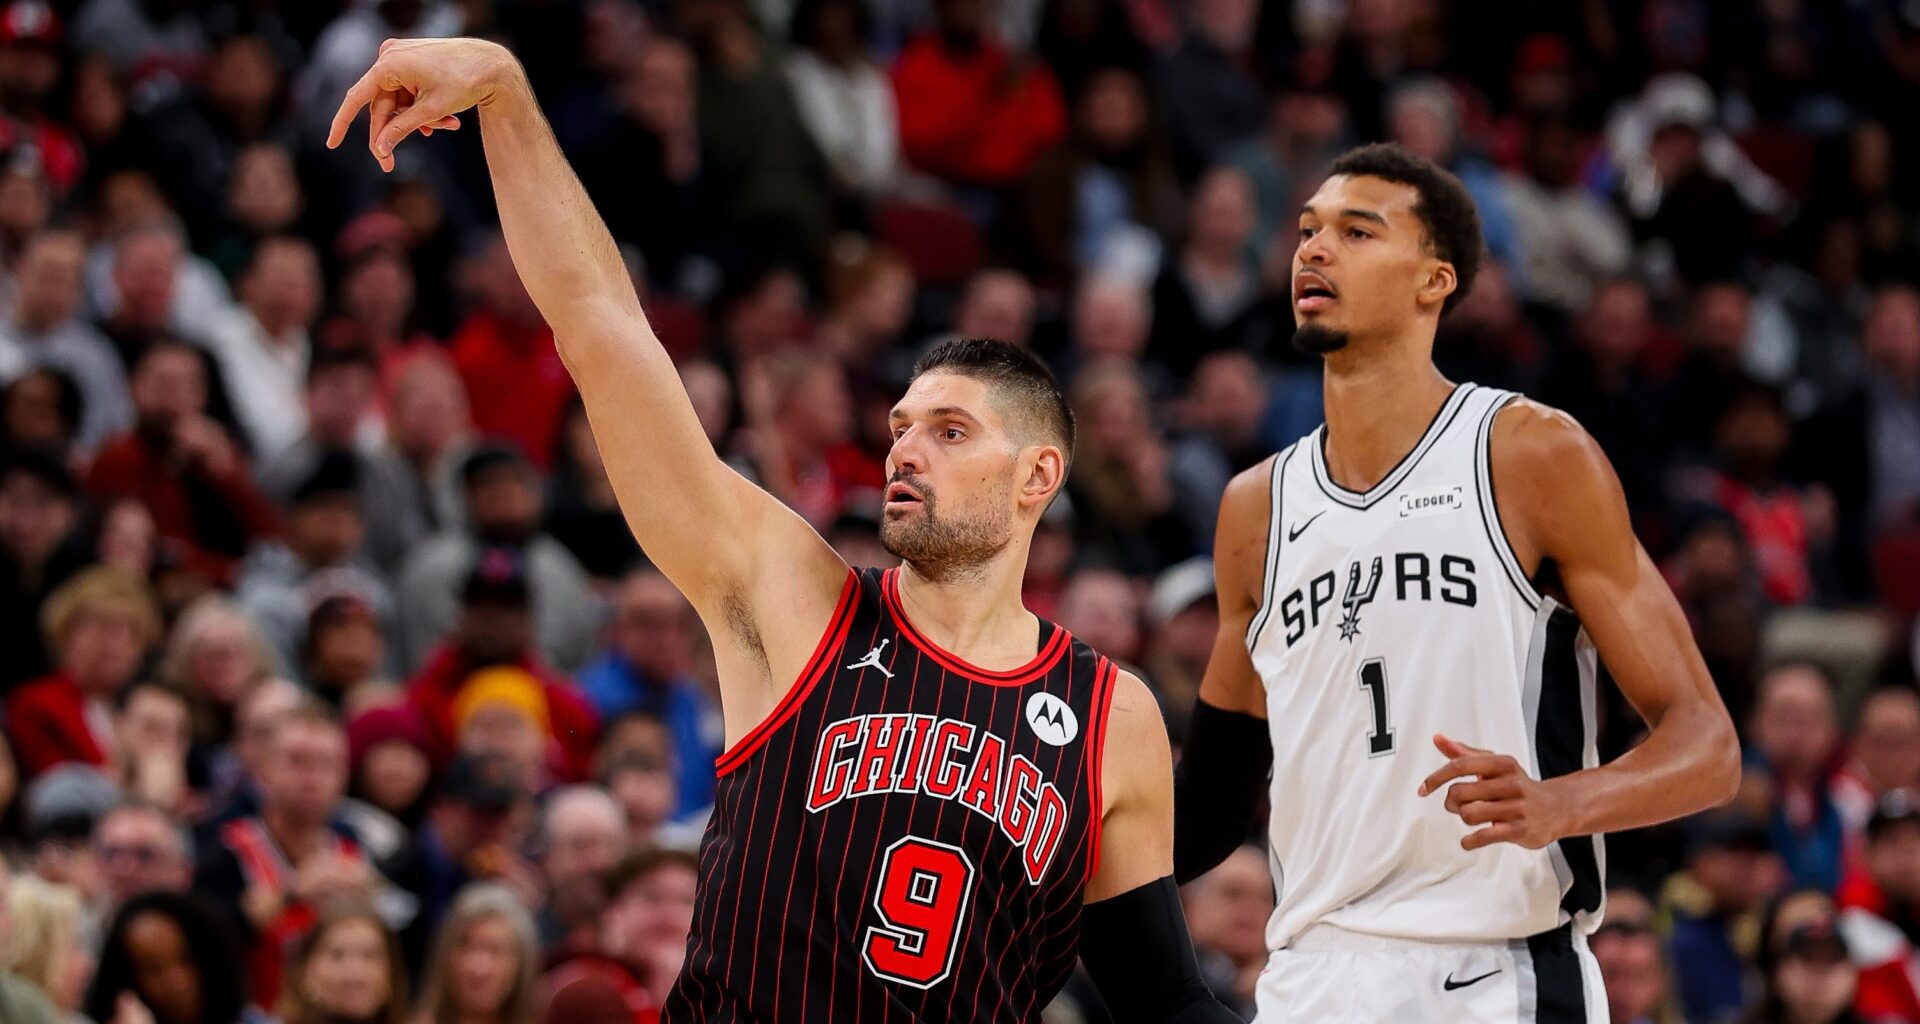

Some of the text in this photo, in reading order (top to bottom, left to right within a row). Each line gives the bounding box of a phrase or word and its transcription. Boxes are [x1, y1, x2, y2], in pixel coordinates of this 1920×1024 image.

[1407, 494, 1454, 510] LEDGER
[1281, 552, 1477, 648] SPURS
[1357, 656, 1396, 759] 1
[806, 713, 1067, 886] CHICAGO
[861, 834, 975, 990] 9
